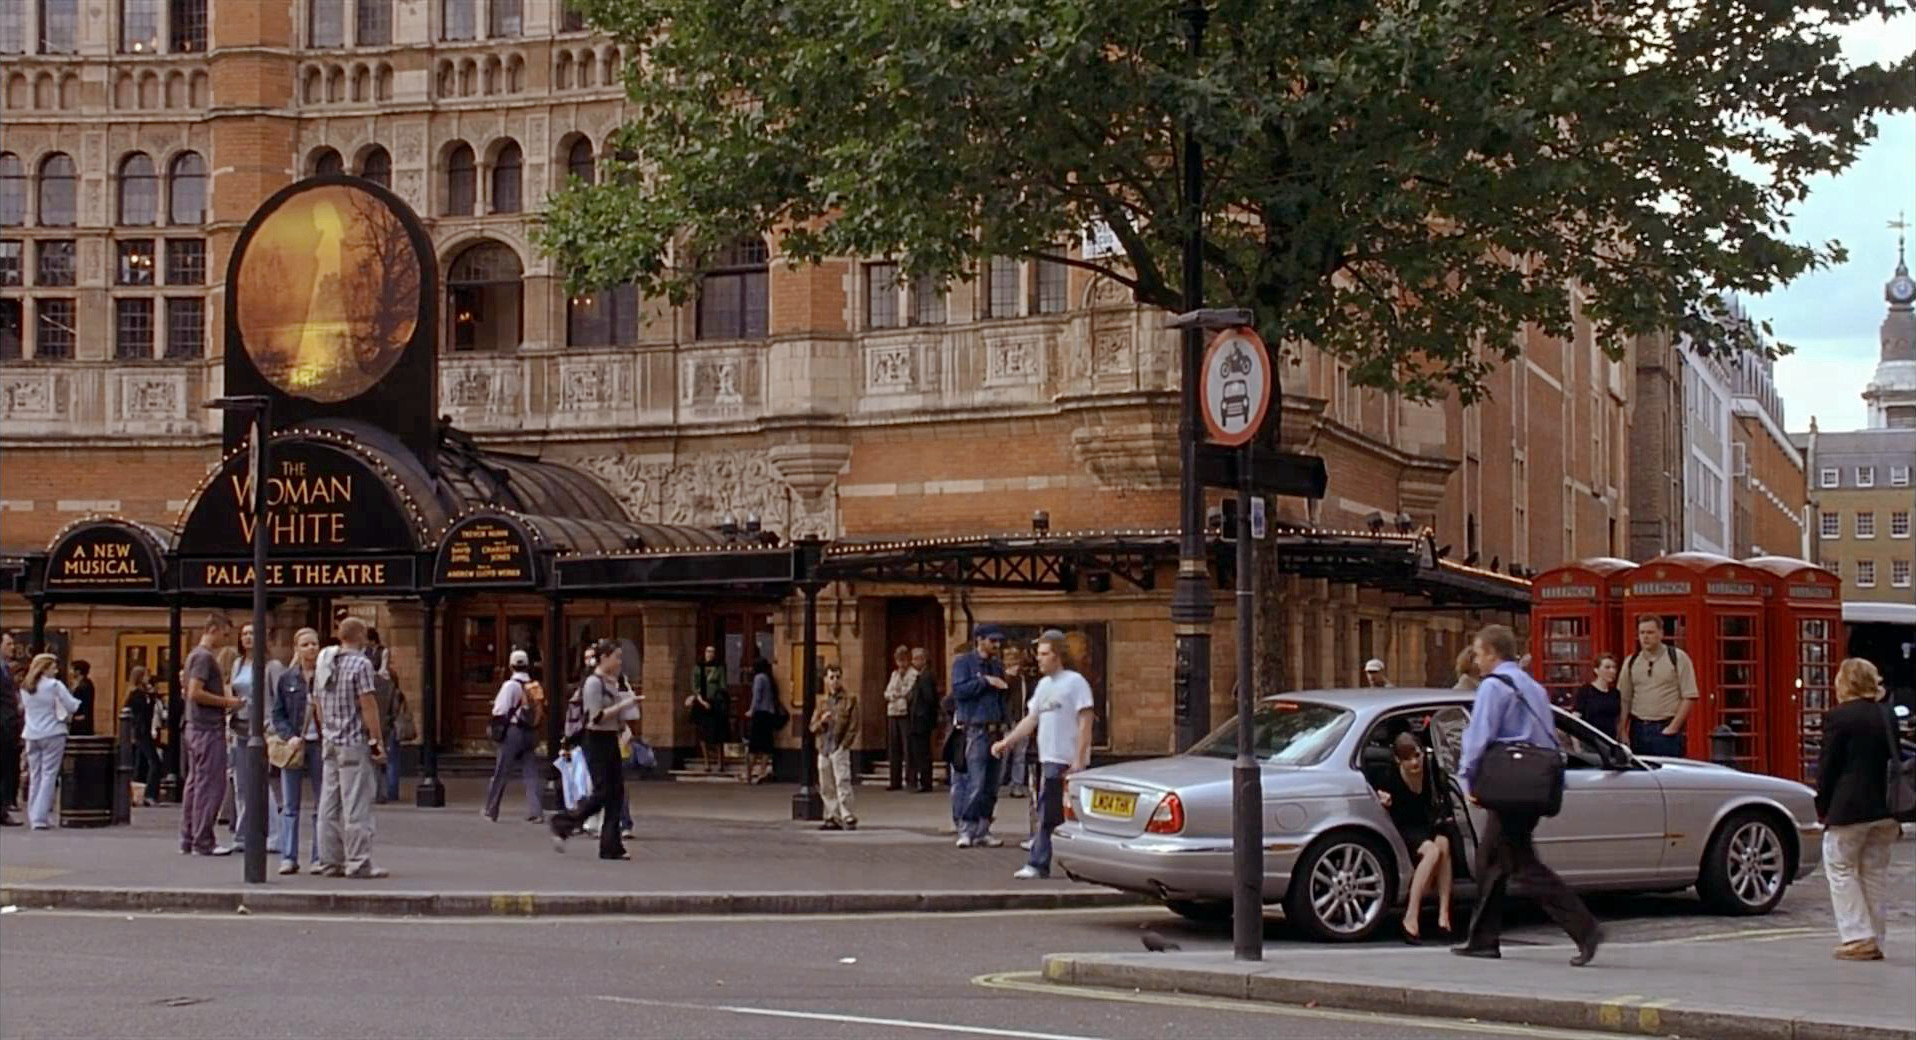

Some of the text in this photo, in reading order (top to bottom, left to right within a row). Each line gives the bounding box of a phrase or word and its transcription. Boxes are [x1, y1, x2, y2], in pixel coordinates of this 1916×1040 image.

[282, 461, 307, 476] THE
[239, 511, 345, 544] WHITE
[73, 543, 131, 558] A NEW
[64, 560, 138, 574] MUSICAL
[292, 564, 385, 585] THEATRE
